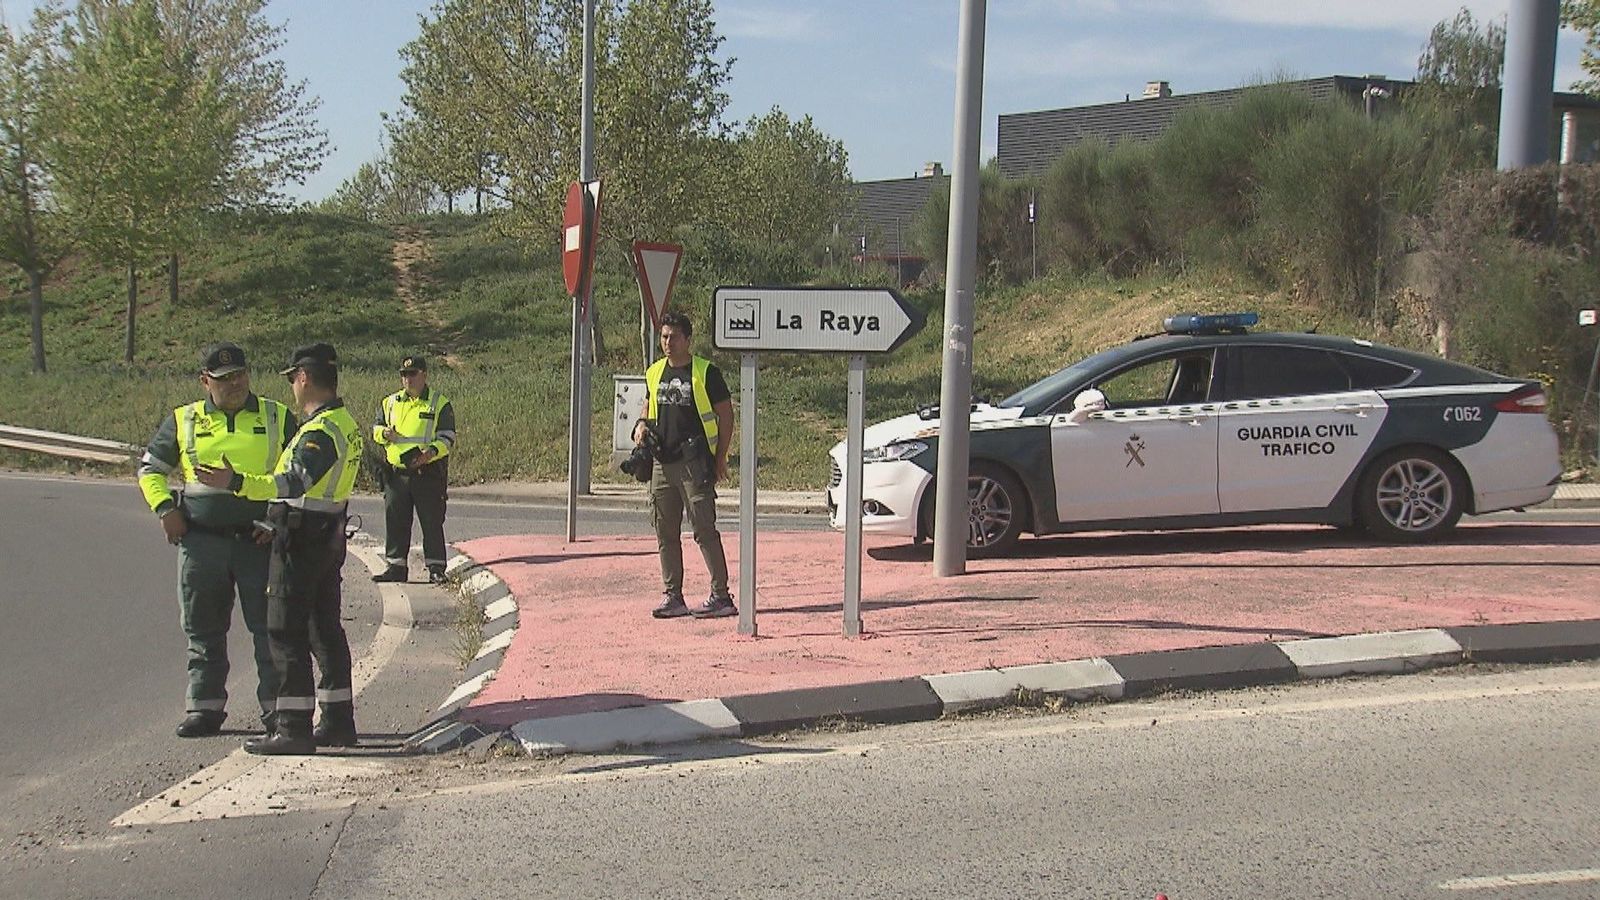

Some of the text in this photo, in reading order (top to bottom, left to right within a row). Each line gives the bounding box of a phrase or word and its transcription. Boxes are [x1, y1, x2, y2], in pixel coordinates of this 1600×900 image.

[776, 309, 881, 336] La Raya
[1454, 406, 1482, 421] 062
[1237, 423, 1359, 440] GUARDIA CIVIL
[1261, 441, 1335, 456] TRAFICO
